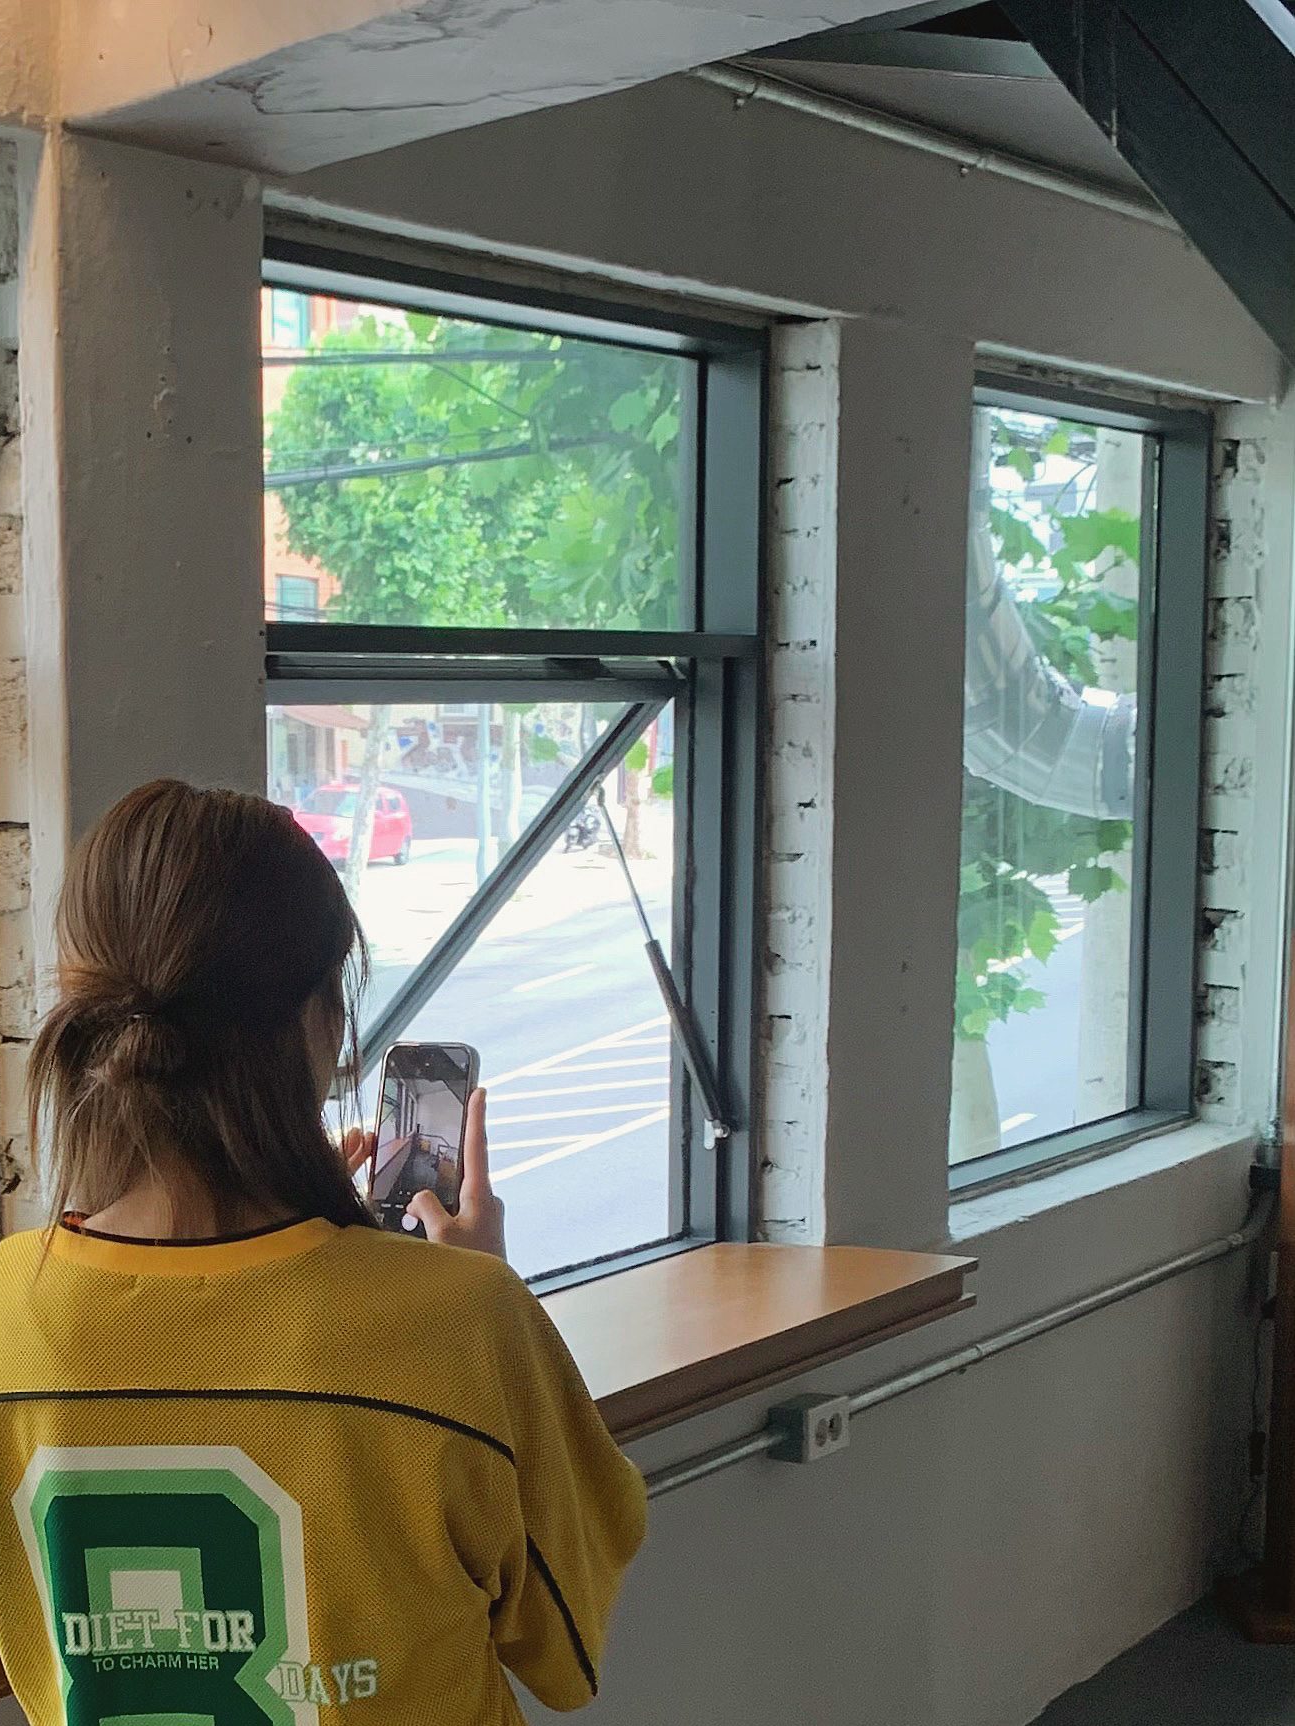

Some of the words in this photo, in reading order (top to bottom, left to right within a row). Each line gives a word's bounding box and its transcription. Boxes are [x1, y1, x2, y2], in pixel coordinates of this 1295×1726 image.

[61, 1609, 160, 1656] DIET
[174, 1609, 256, 1653] FOR
[92, 1658, 115, 1673] TO
[119, 1654, 182, 1671] CHARM
[186, 1656, 219, 1671] HER
[278, 1659, 378, 1705] DAYS
